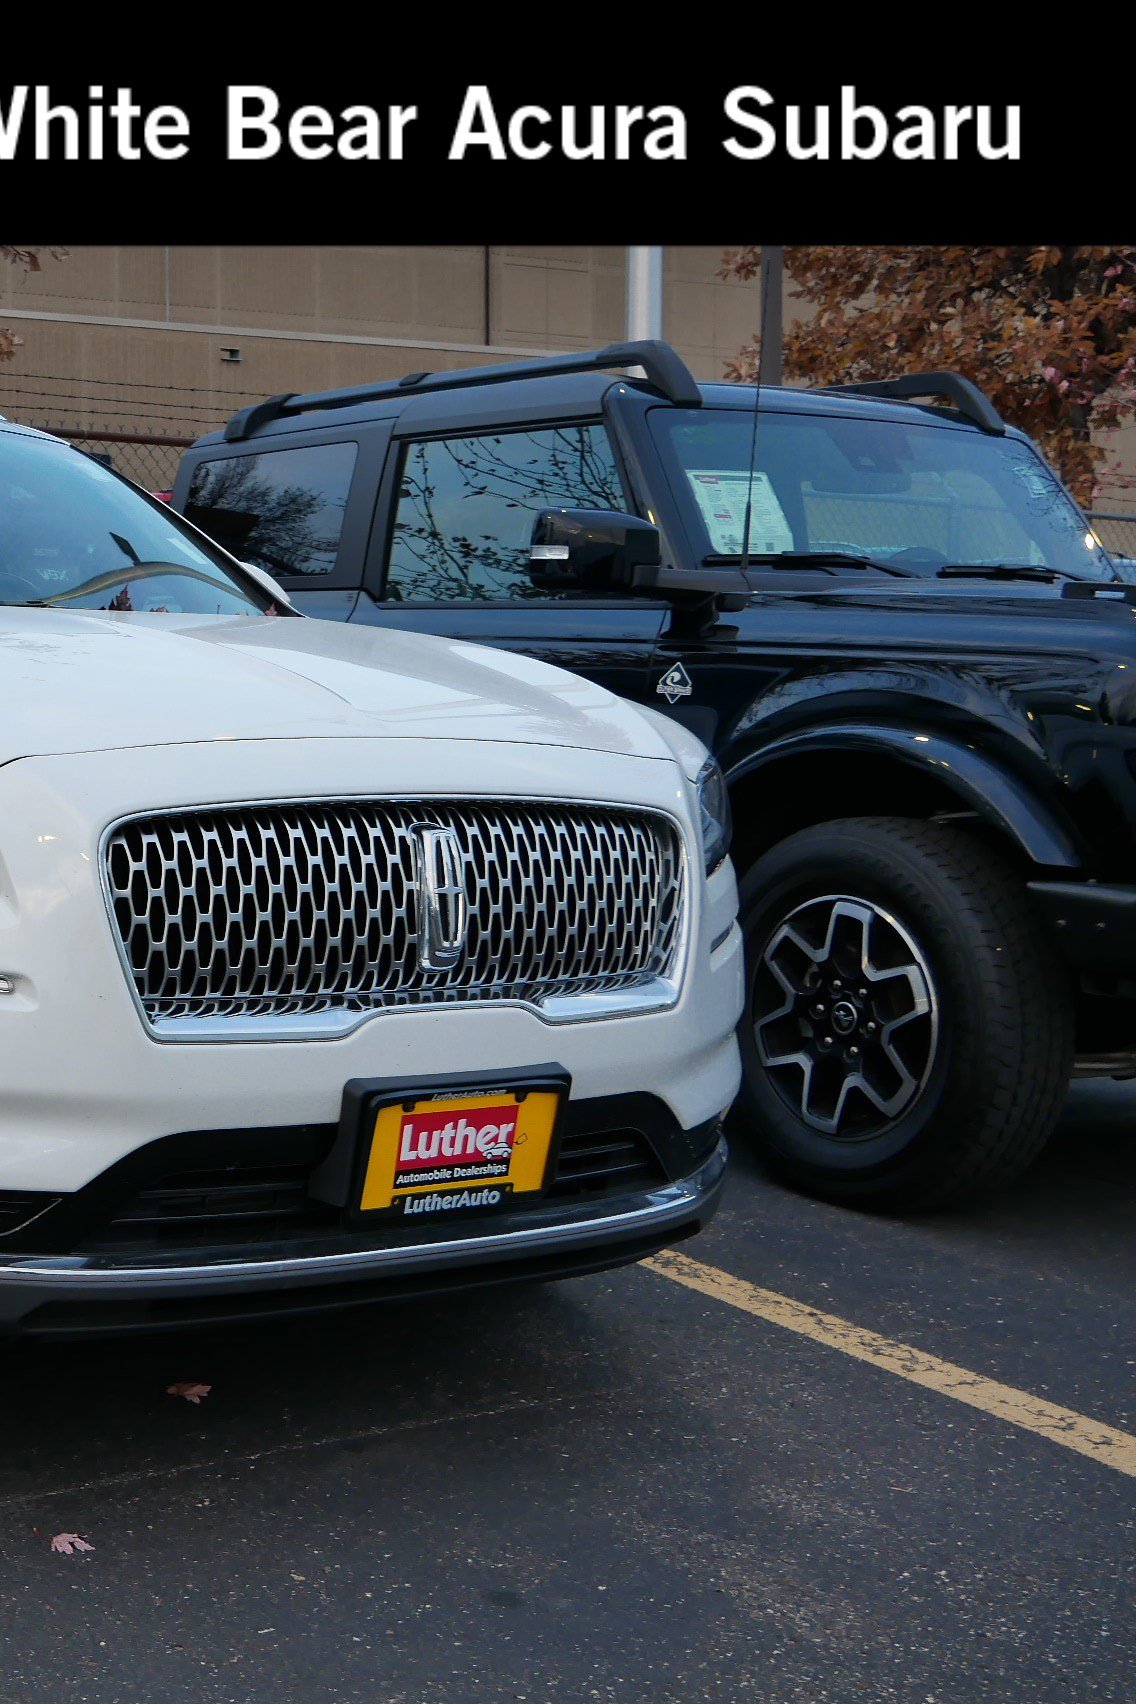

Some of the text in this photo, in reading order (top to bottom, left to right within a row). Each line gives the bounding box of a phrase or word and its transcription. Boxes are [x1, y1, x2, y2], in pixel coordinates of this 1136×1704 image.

[431, 1089, 507, 1102] LutherAuto.com
[400, 1119, 514, 1161] Luther
[396, 1164, 507, 1184] Automobile Dealerships
[404, 1189, 500, 1214] LutherAuto
